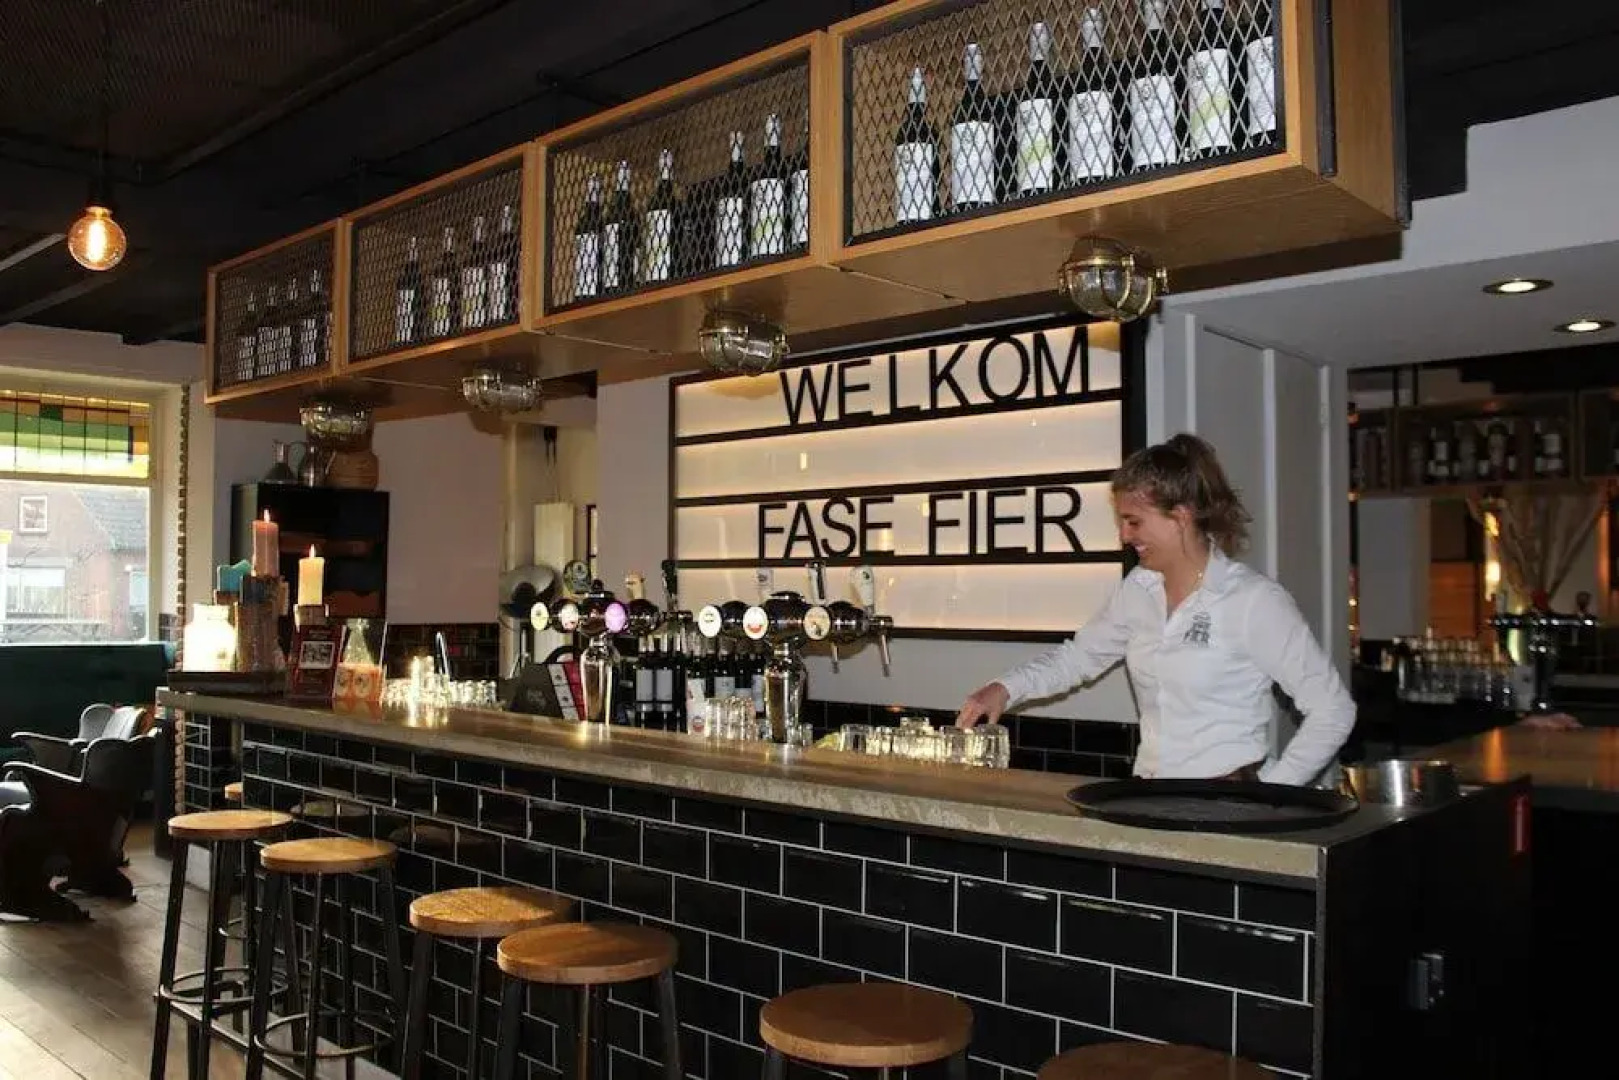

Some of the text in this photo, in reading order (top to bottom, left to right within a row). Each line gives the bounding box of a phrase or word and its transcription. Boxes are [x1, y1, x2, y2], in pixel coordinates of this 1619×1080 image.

[780, 328, 1089, 426] WELKOM
[758, 486, 1082, 559] FASE FIER
